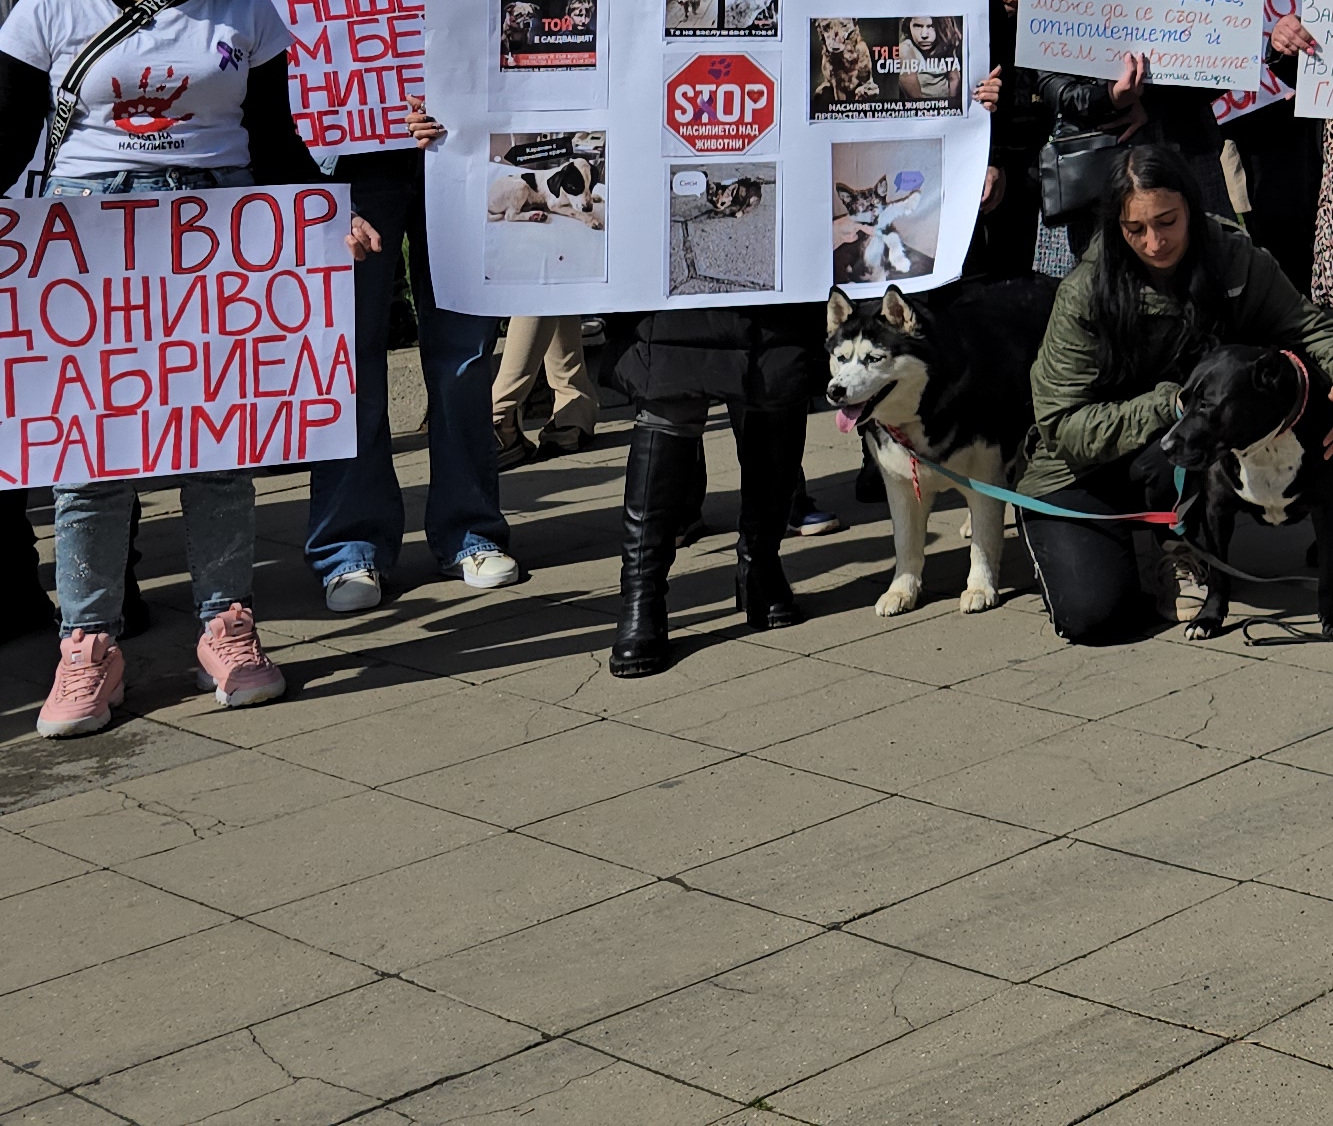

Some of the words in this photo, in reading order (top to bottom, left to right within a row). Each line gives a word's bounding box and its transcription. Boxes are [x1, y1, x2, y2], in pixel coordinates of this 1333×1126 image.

[541, 15, 573, 31] ТОЙ
[872, 46, 889, 61] ТЯ
[892, 46, 899, 60] Е
[876, 56, 961, 75] СЛЕДВАЩАТА
[674, 83, 768, 124] STOP
[828, 102, 882, 112] НАСИЛИЕТО
[884, 101, 903, 110] НАД
[904, 99, 949, 109] ЖИВОТНИ
[679, 124, 737, 136] НАСИЛИЕТО
[738, 124, 760, 137] НАД
[695, 138, 743, 150] ЖИВОТНИ
[4, 334, 357, 418] ГАБРИЕЛА
